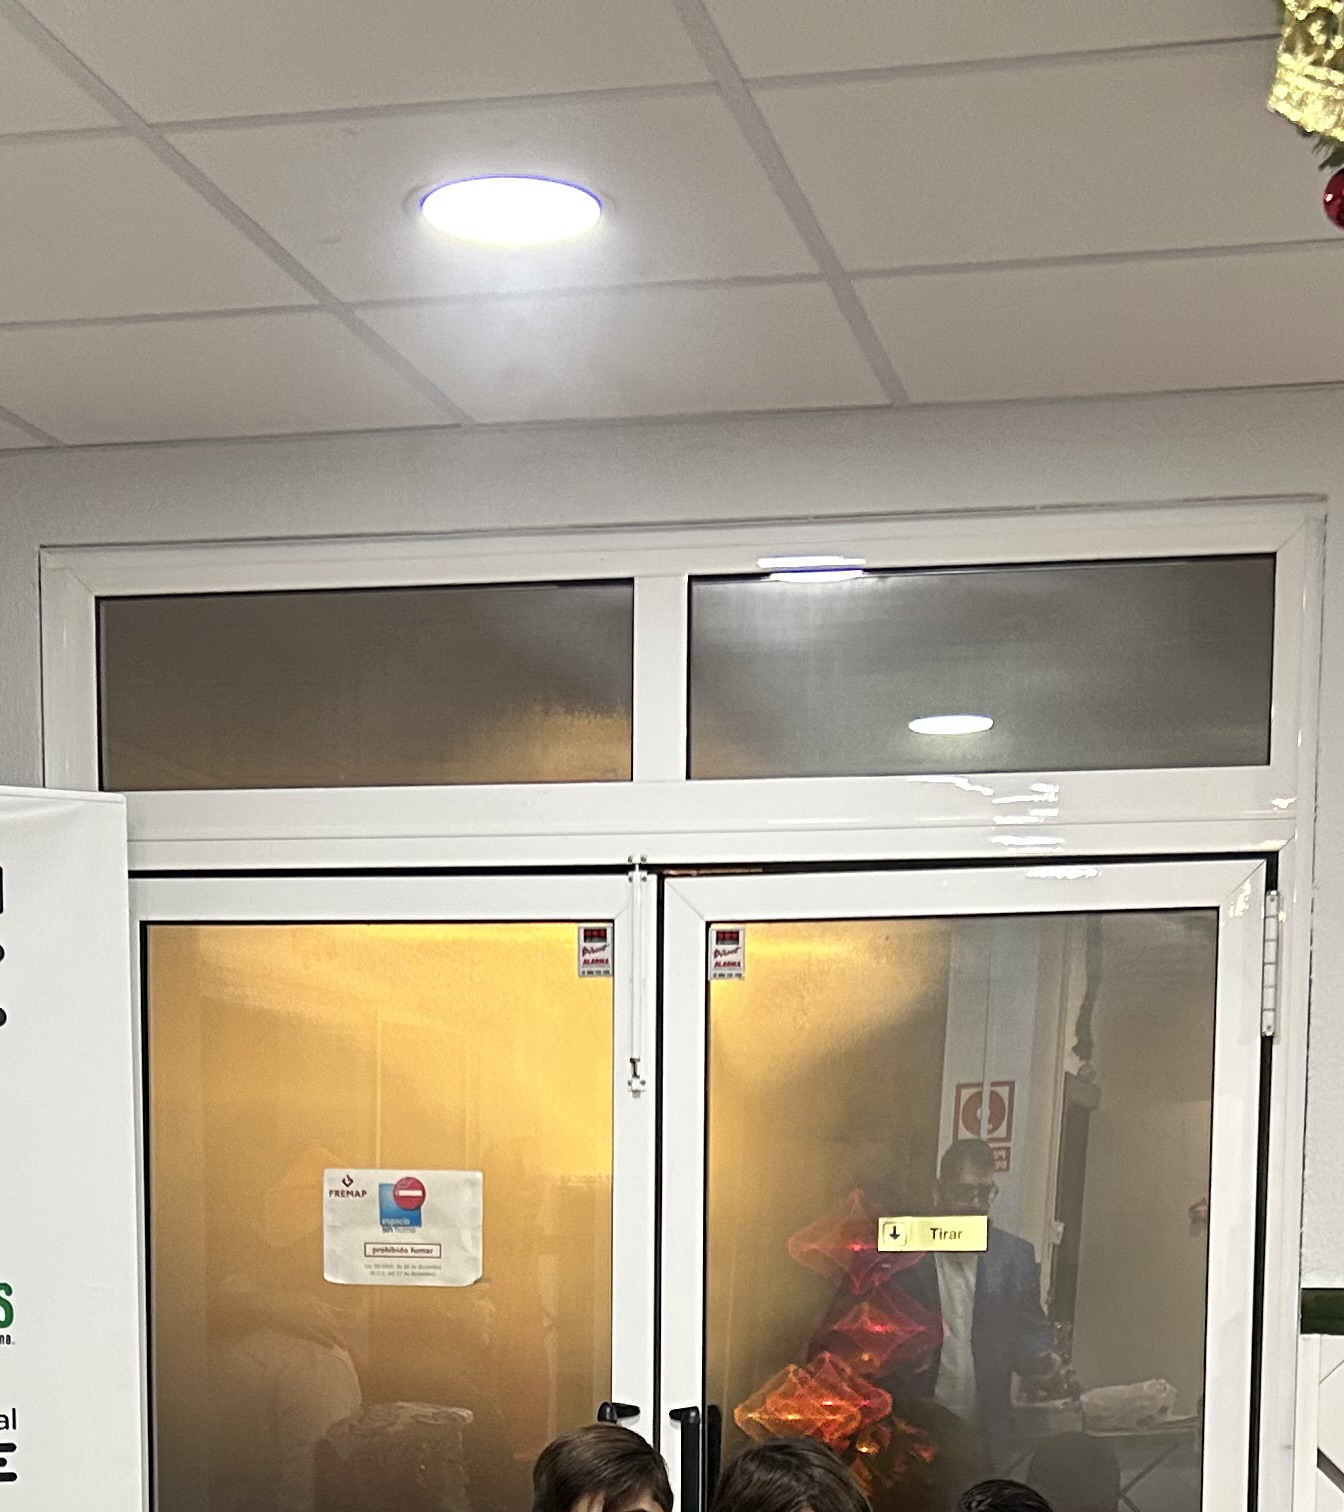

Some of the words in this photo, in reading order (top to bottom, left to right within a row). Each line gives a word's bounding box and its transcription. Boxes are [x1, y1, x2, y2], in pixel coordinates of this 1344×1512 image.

[329, 1189, 367, 1198] FREMAP
[929, 1227, 963, 1241] Tirar
[372, 1246, 408, 1256] prohibido
[410, 1246, 434, 1255] fumar
